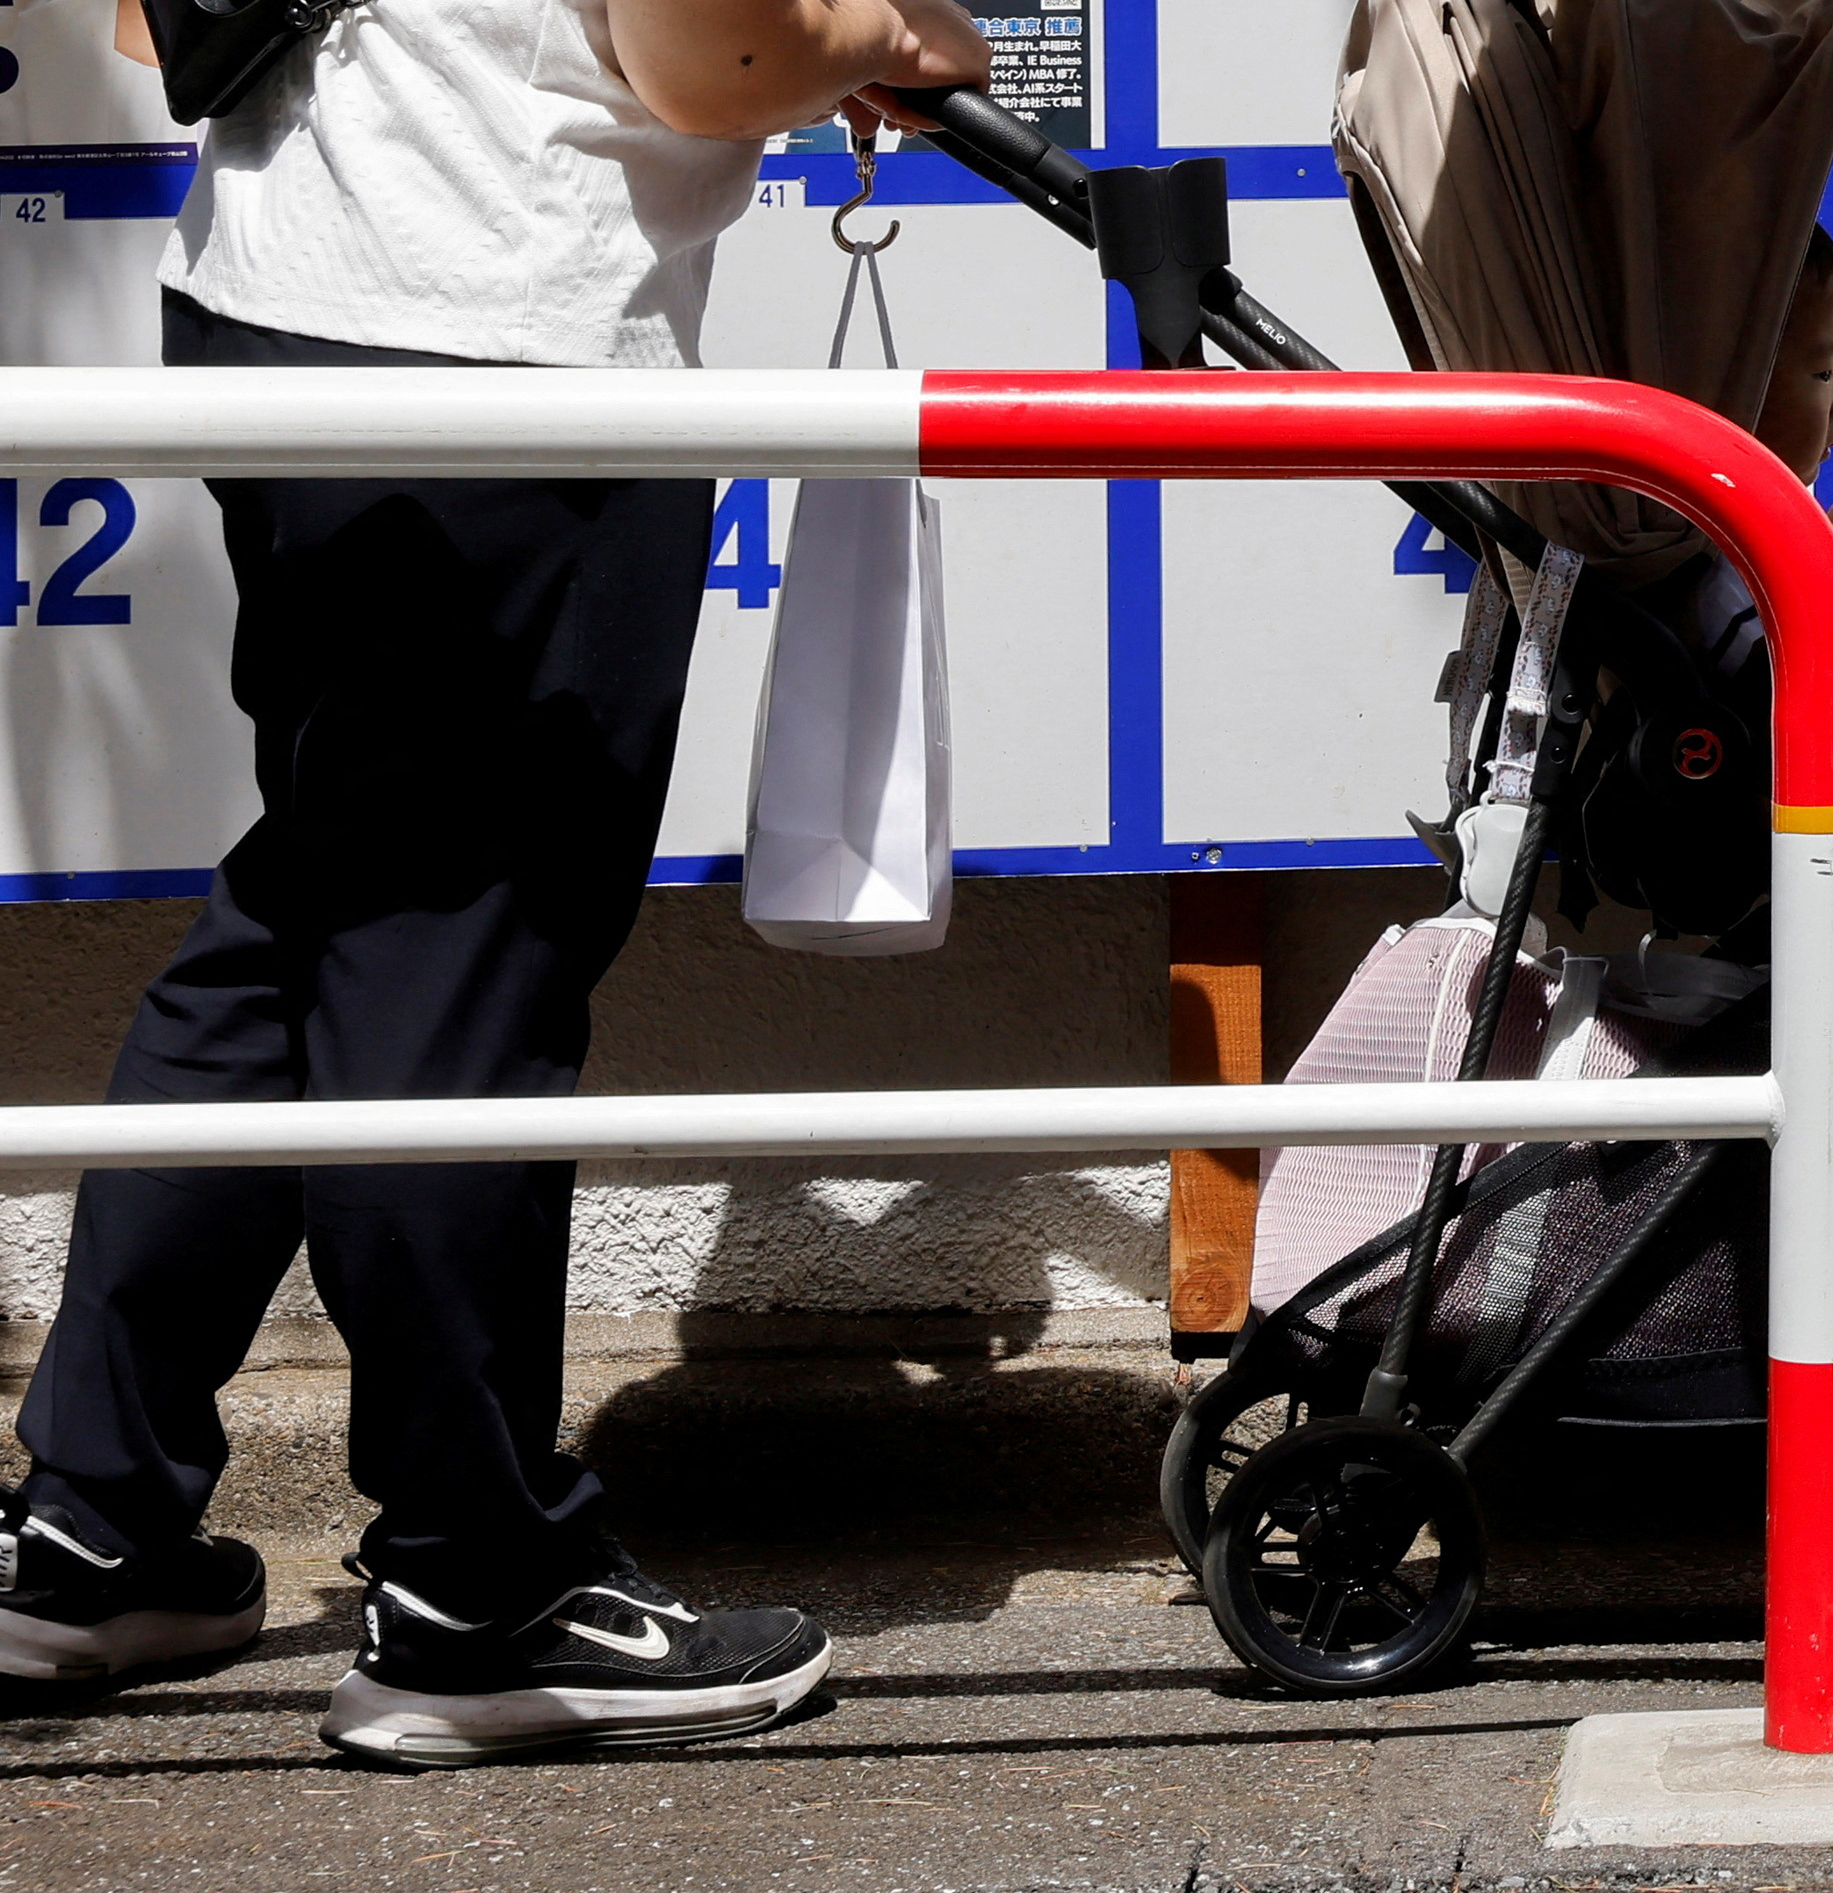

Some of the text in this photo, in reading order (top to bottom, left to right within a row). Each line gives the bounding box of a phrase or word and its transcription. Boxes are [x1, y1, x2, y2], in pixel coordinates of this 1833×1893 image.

[1040, 55, 1082, 66] Business
[1029, 69, 1055, 79] MBA
[759, 184, 785, 208] 41
[16, 198, 46, 223] 42
[1255, 317, 1286, 345] MELIO
